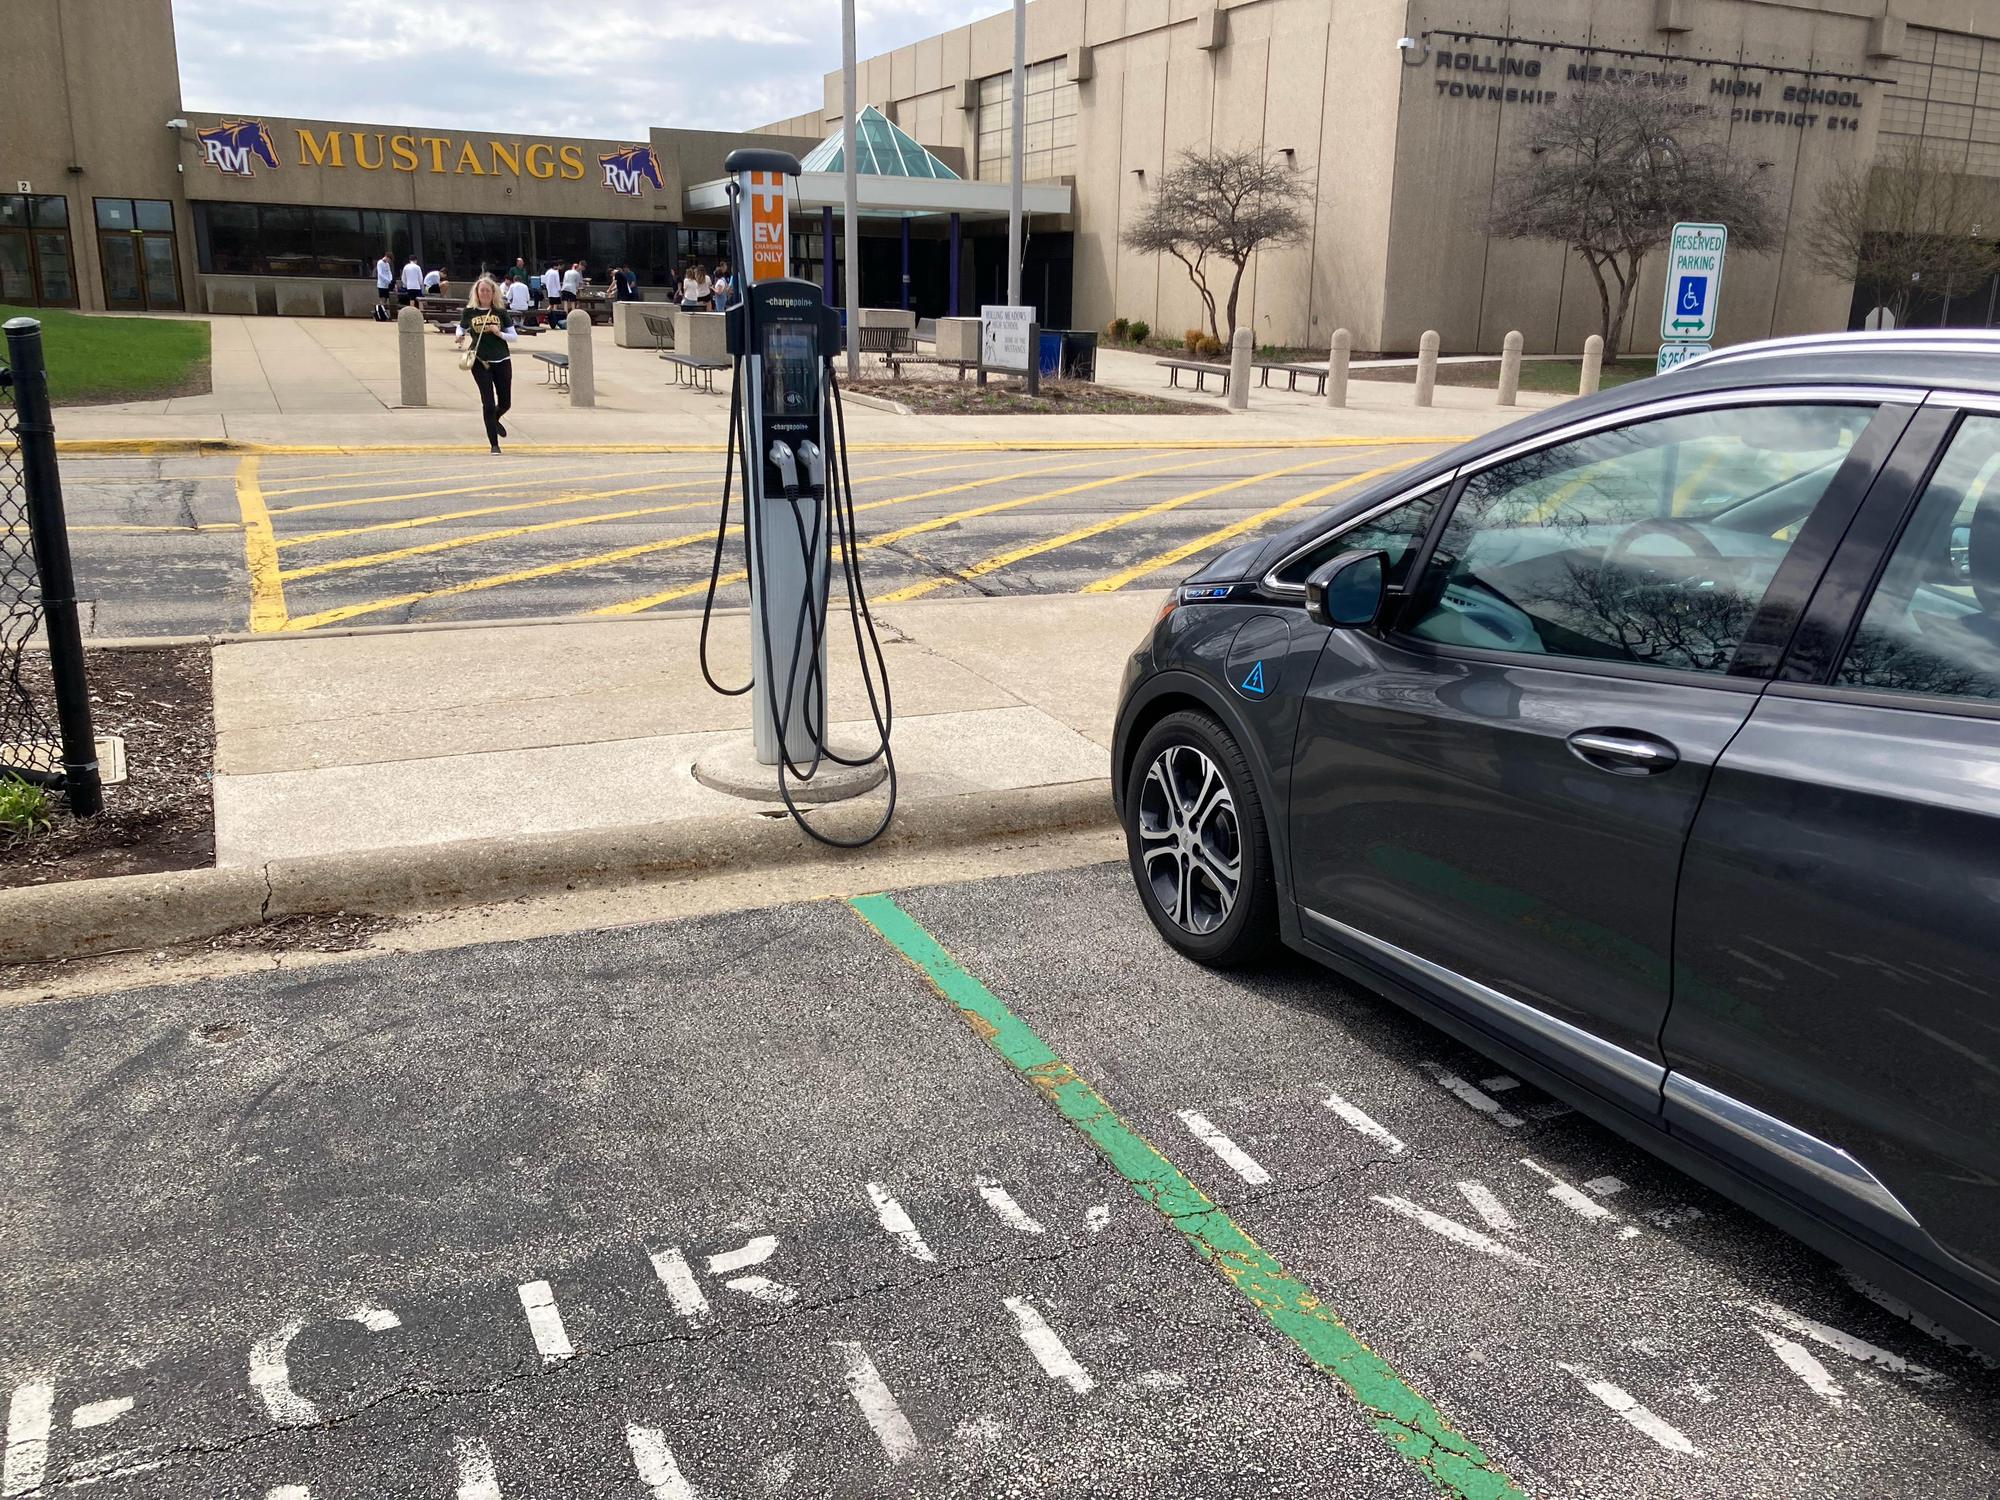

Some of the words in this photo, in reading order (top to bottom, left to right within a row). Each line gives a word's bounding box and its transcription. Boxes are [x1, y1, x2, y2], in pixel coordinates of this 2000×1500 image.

[1436, 51, 1541, 77] ROLLING
[1710, 77, 1762, 98] HIGH
[1783, 86, 1863, 108] SCHOOL
[1435, 80, 1557, 105] TOWNSHIP
[1731, 107, 1818, 128] DISTRICT
[1827, 116, 1859, 131] 214
[203, 139, 252, 175] RM
[296, 128, 586, 180] MUSTANGS
[603, 163, 641, 196] RM
[754, 222, 782, 243] EV
[1675, 235, 1722, 251] RESERVED
[755, 251, 783, 263] ONLY
[1677, 255, 1715, 270] PARKING
